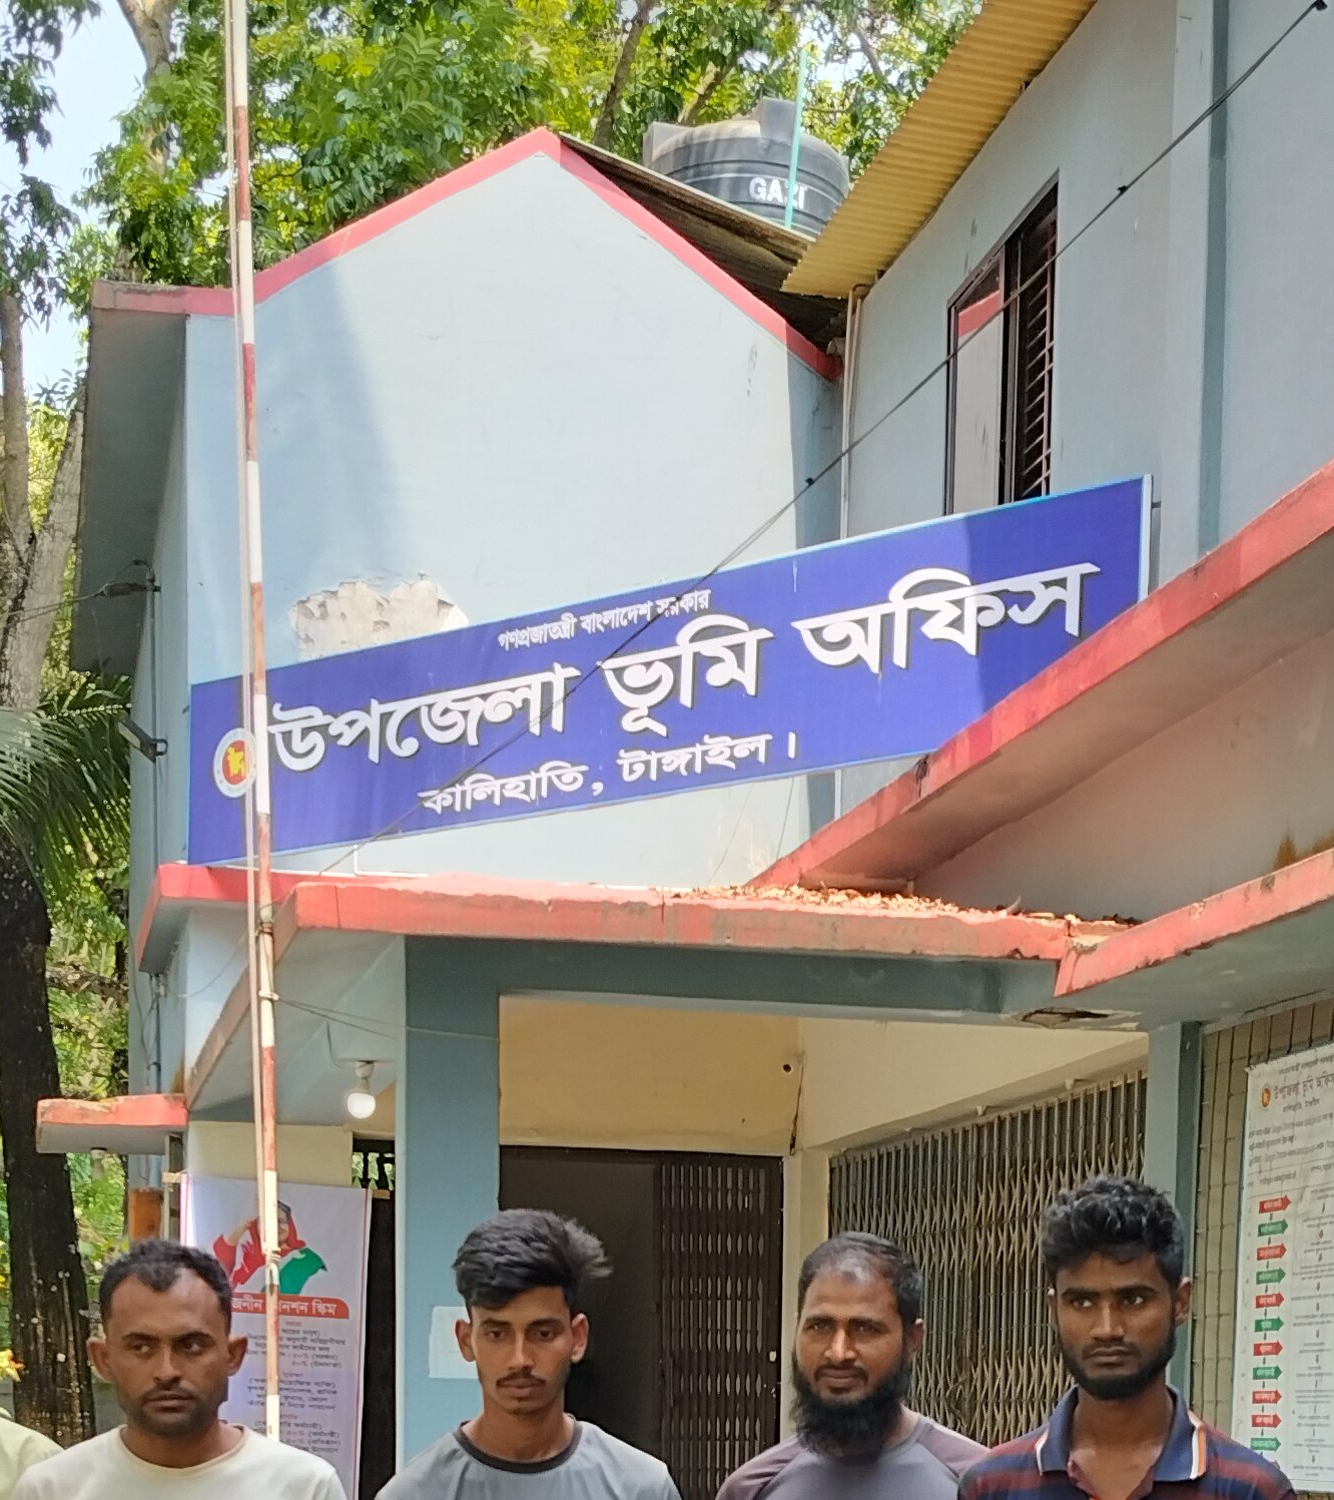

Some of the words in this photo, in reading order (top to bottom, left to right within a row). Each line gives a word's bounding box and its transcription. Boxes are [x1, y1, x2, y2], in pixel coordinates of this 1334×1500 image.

[268, 661, 581, 773] উপজেলা
[597, 613, 774, 738] ভূমি
[791, 563, 1101, 676] অফিস
[580, 601, 651, 635] বাংলাদেশ
[656, 589, 711, 618] সরকার
